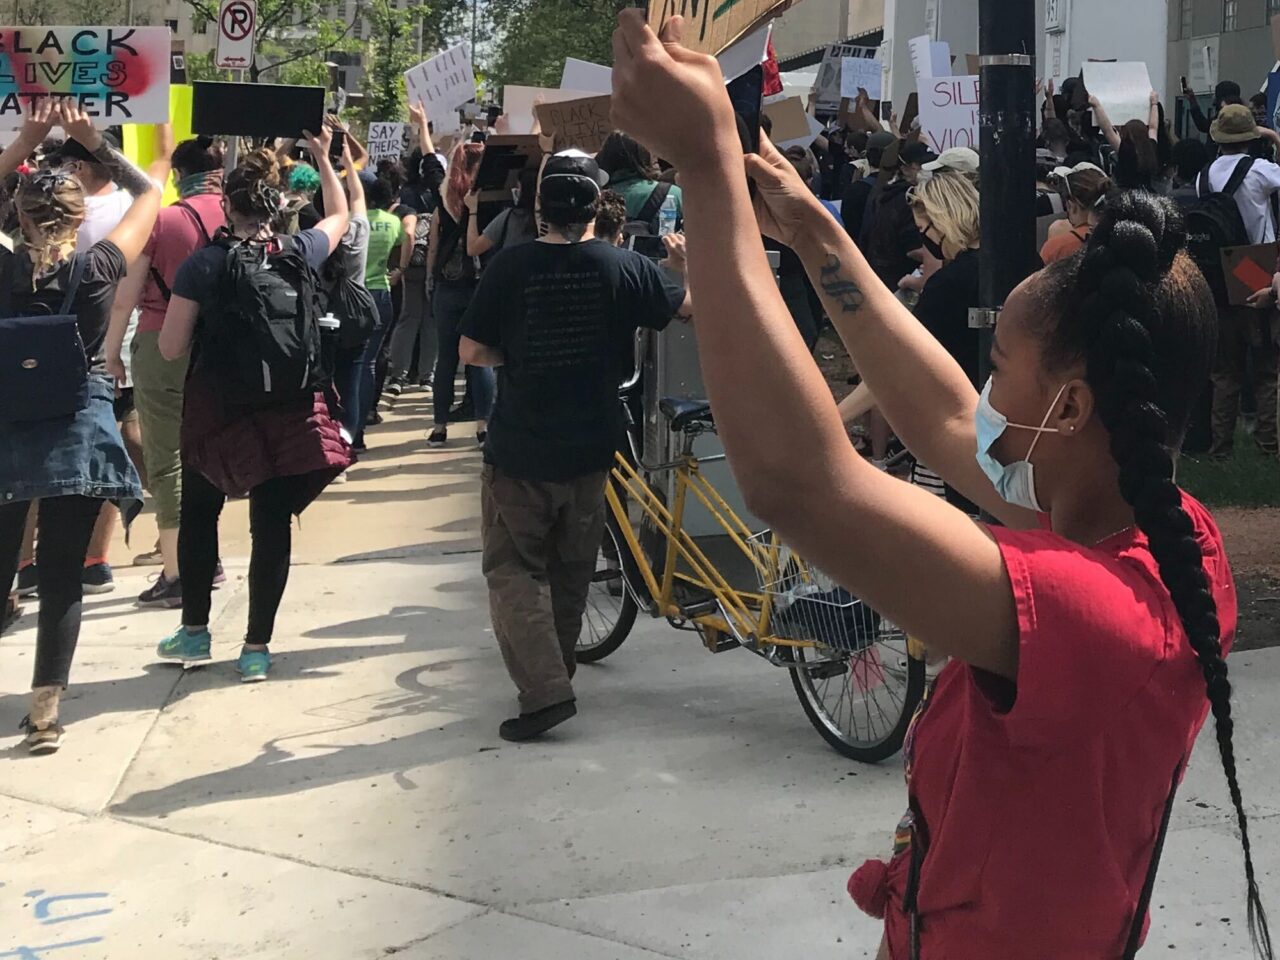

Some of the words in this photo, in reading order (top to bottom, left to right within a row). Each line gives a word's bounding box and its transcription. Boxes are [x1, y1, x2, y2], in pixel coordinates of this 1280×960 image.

[0, 29, 138, 56] LACK
[370, 124, 398, 140] SAY
[562, 119, 609, 139] LIVE
[368, 139, 400, 155] THEIR
